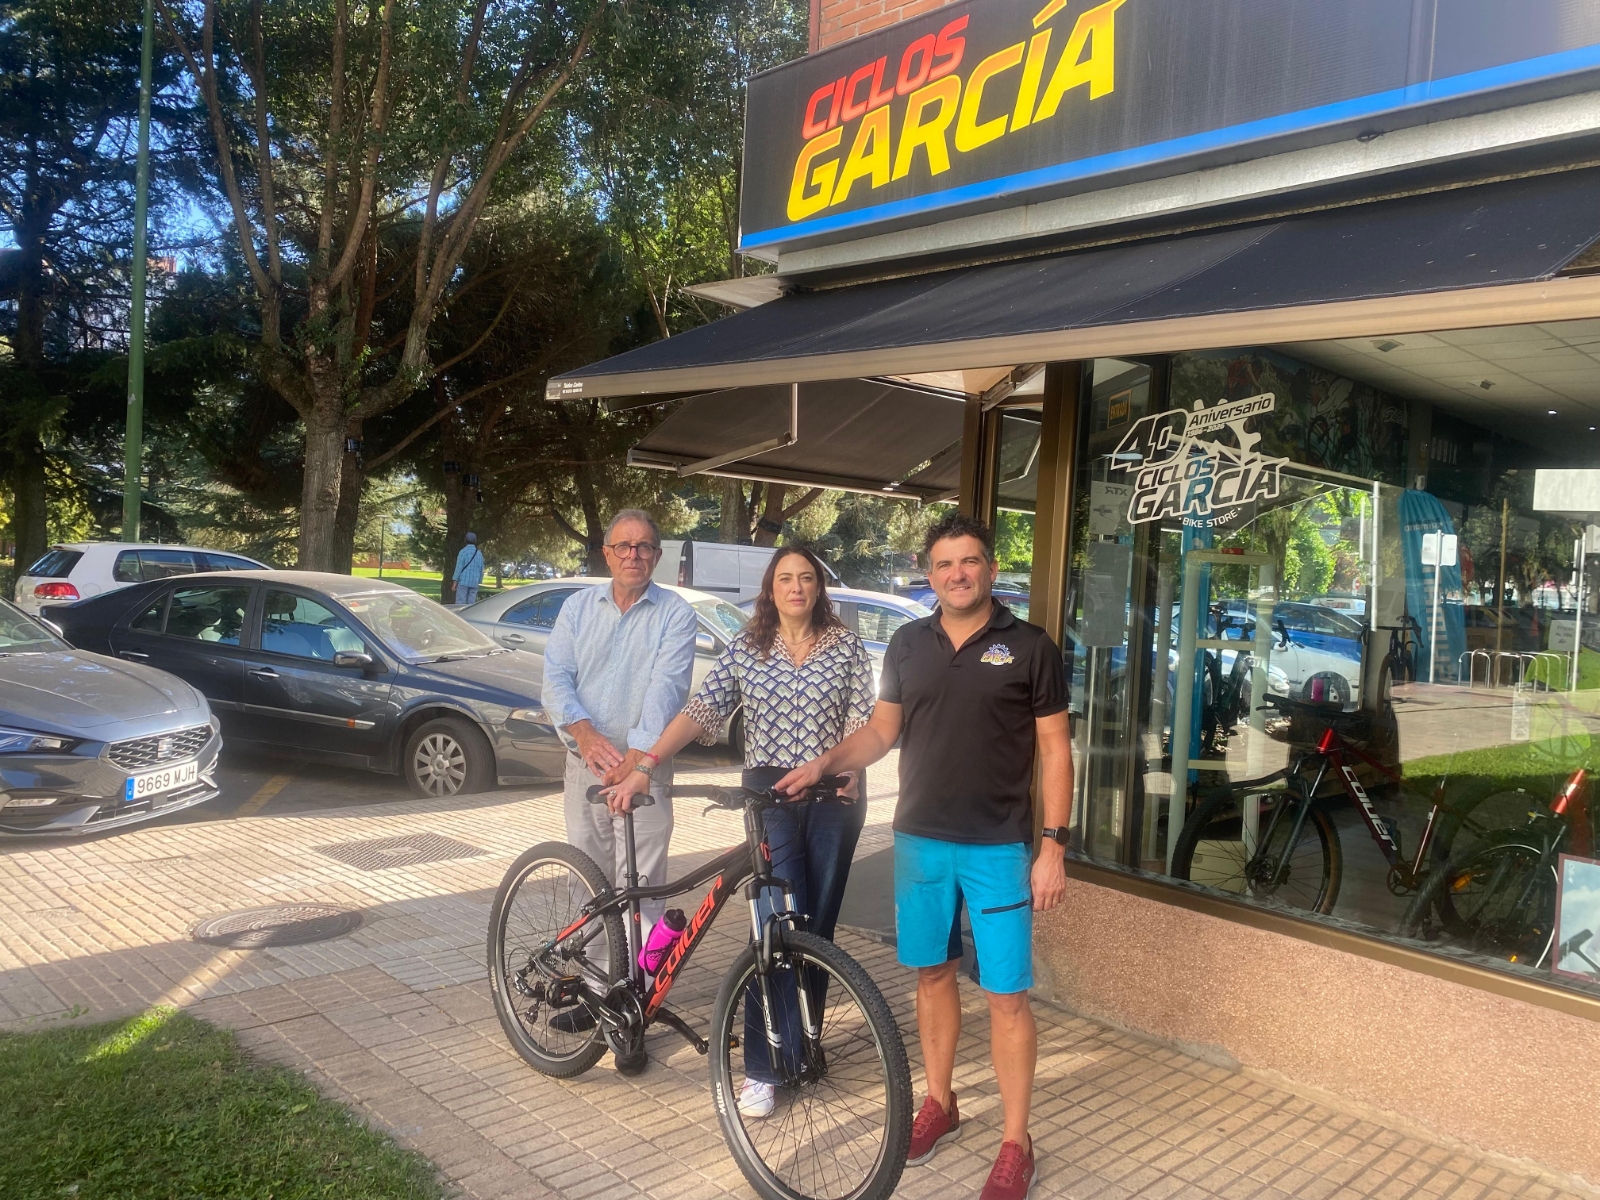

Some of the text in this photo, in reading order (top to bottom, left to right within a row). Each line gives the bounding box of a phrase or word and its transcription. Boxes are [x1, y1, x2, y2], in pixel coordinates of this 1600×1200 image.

[802, 14, 969, 140] CICLOS
[786, 0, 1127, 222] GARCÍA
[1111, 396, 1271, 472] 40 Aniversario
[1137, 456, 1217, 491] CICLOS
[1182, 510, 1238, 528] BIKE STORE
[137, 767, 196, 794] 9669 MJH
[715, 1081, 727, 1116] Mitas
